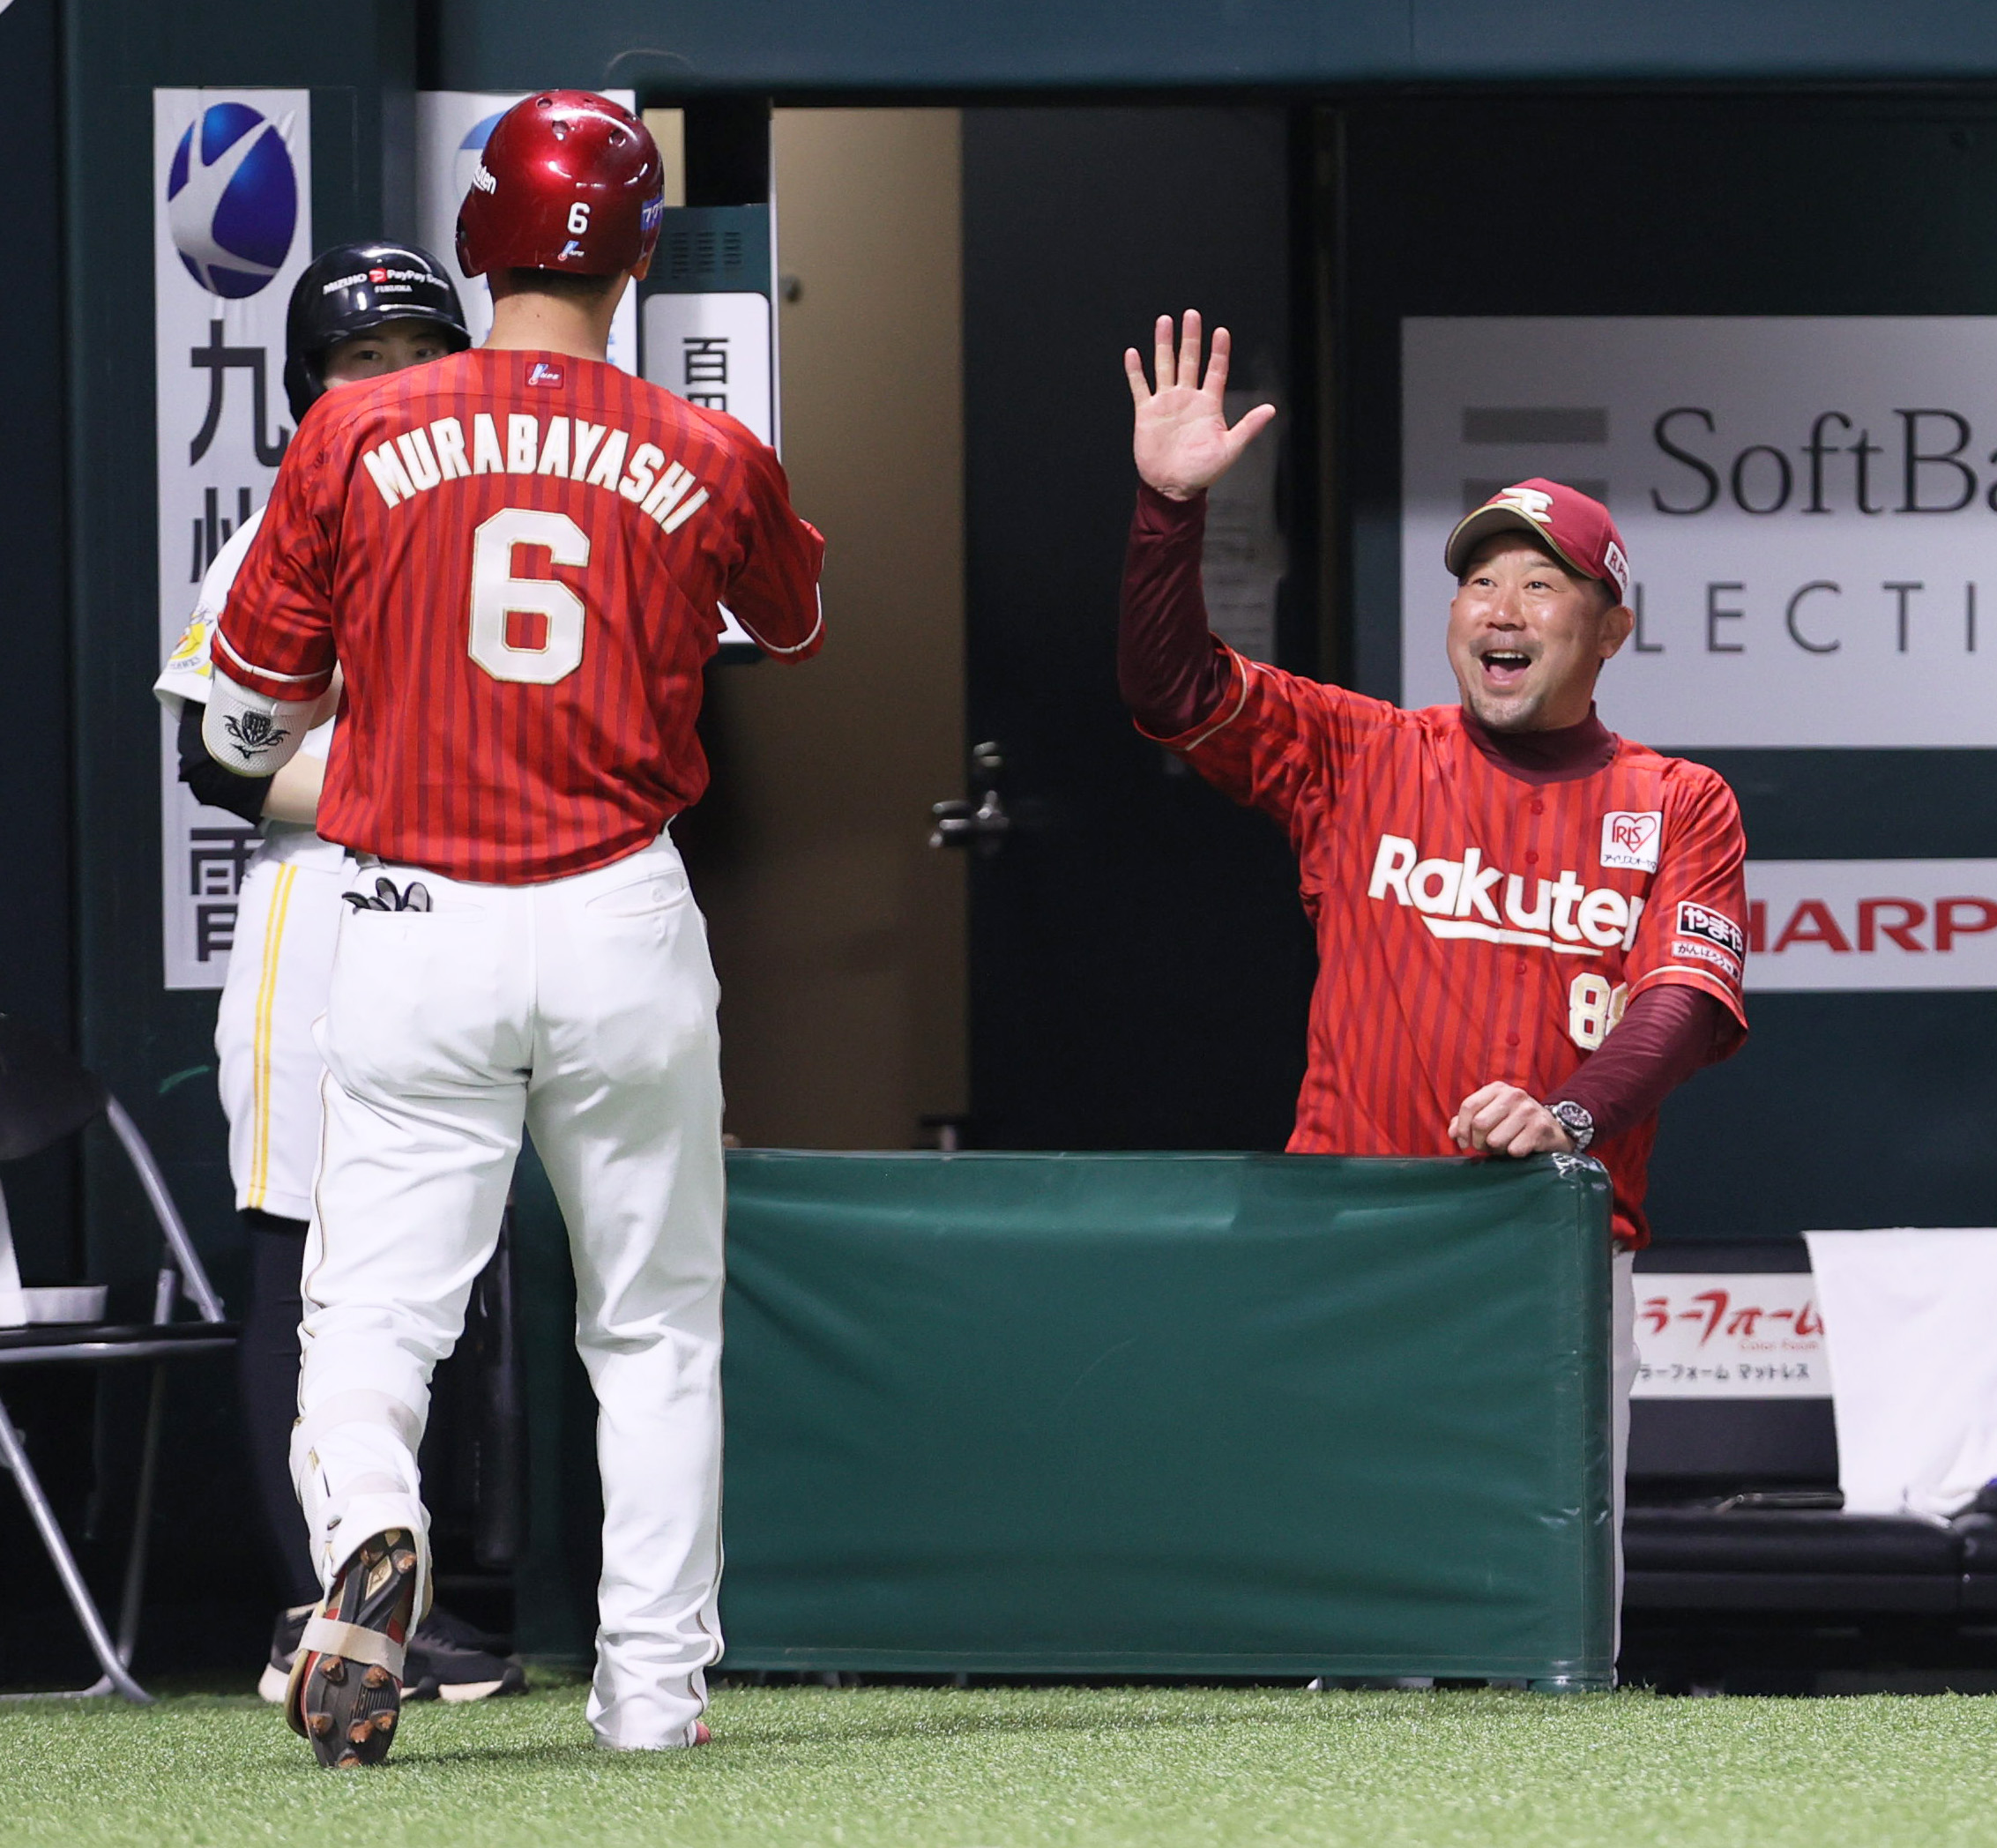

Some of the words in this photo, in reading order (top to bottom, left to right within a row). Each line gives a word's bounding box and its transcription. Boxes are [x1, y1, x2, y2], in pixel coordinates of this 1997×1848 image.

[568, 202, 591, 235] 6
[387, 269, 426, 282] PayPay
[362, 413, 711, 535] MURABAYASHI
[467, 508, 591, 685] 6
[1633, 581, 1976, 653] LECTI
[1683, 906, 1743, 952] やまや
[1638, 1288, 1825, 1347] ラーフォーム
[1640, 1364, 1729, 1380] ラーフォーム
